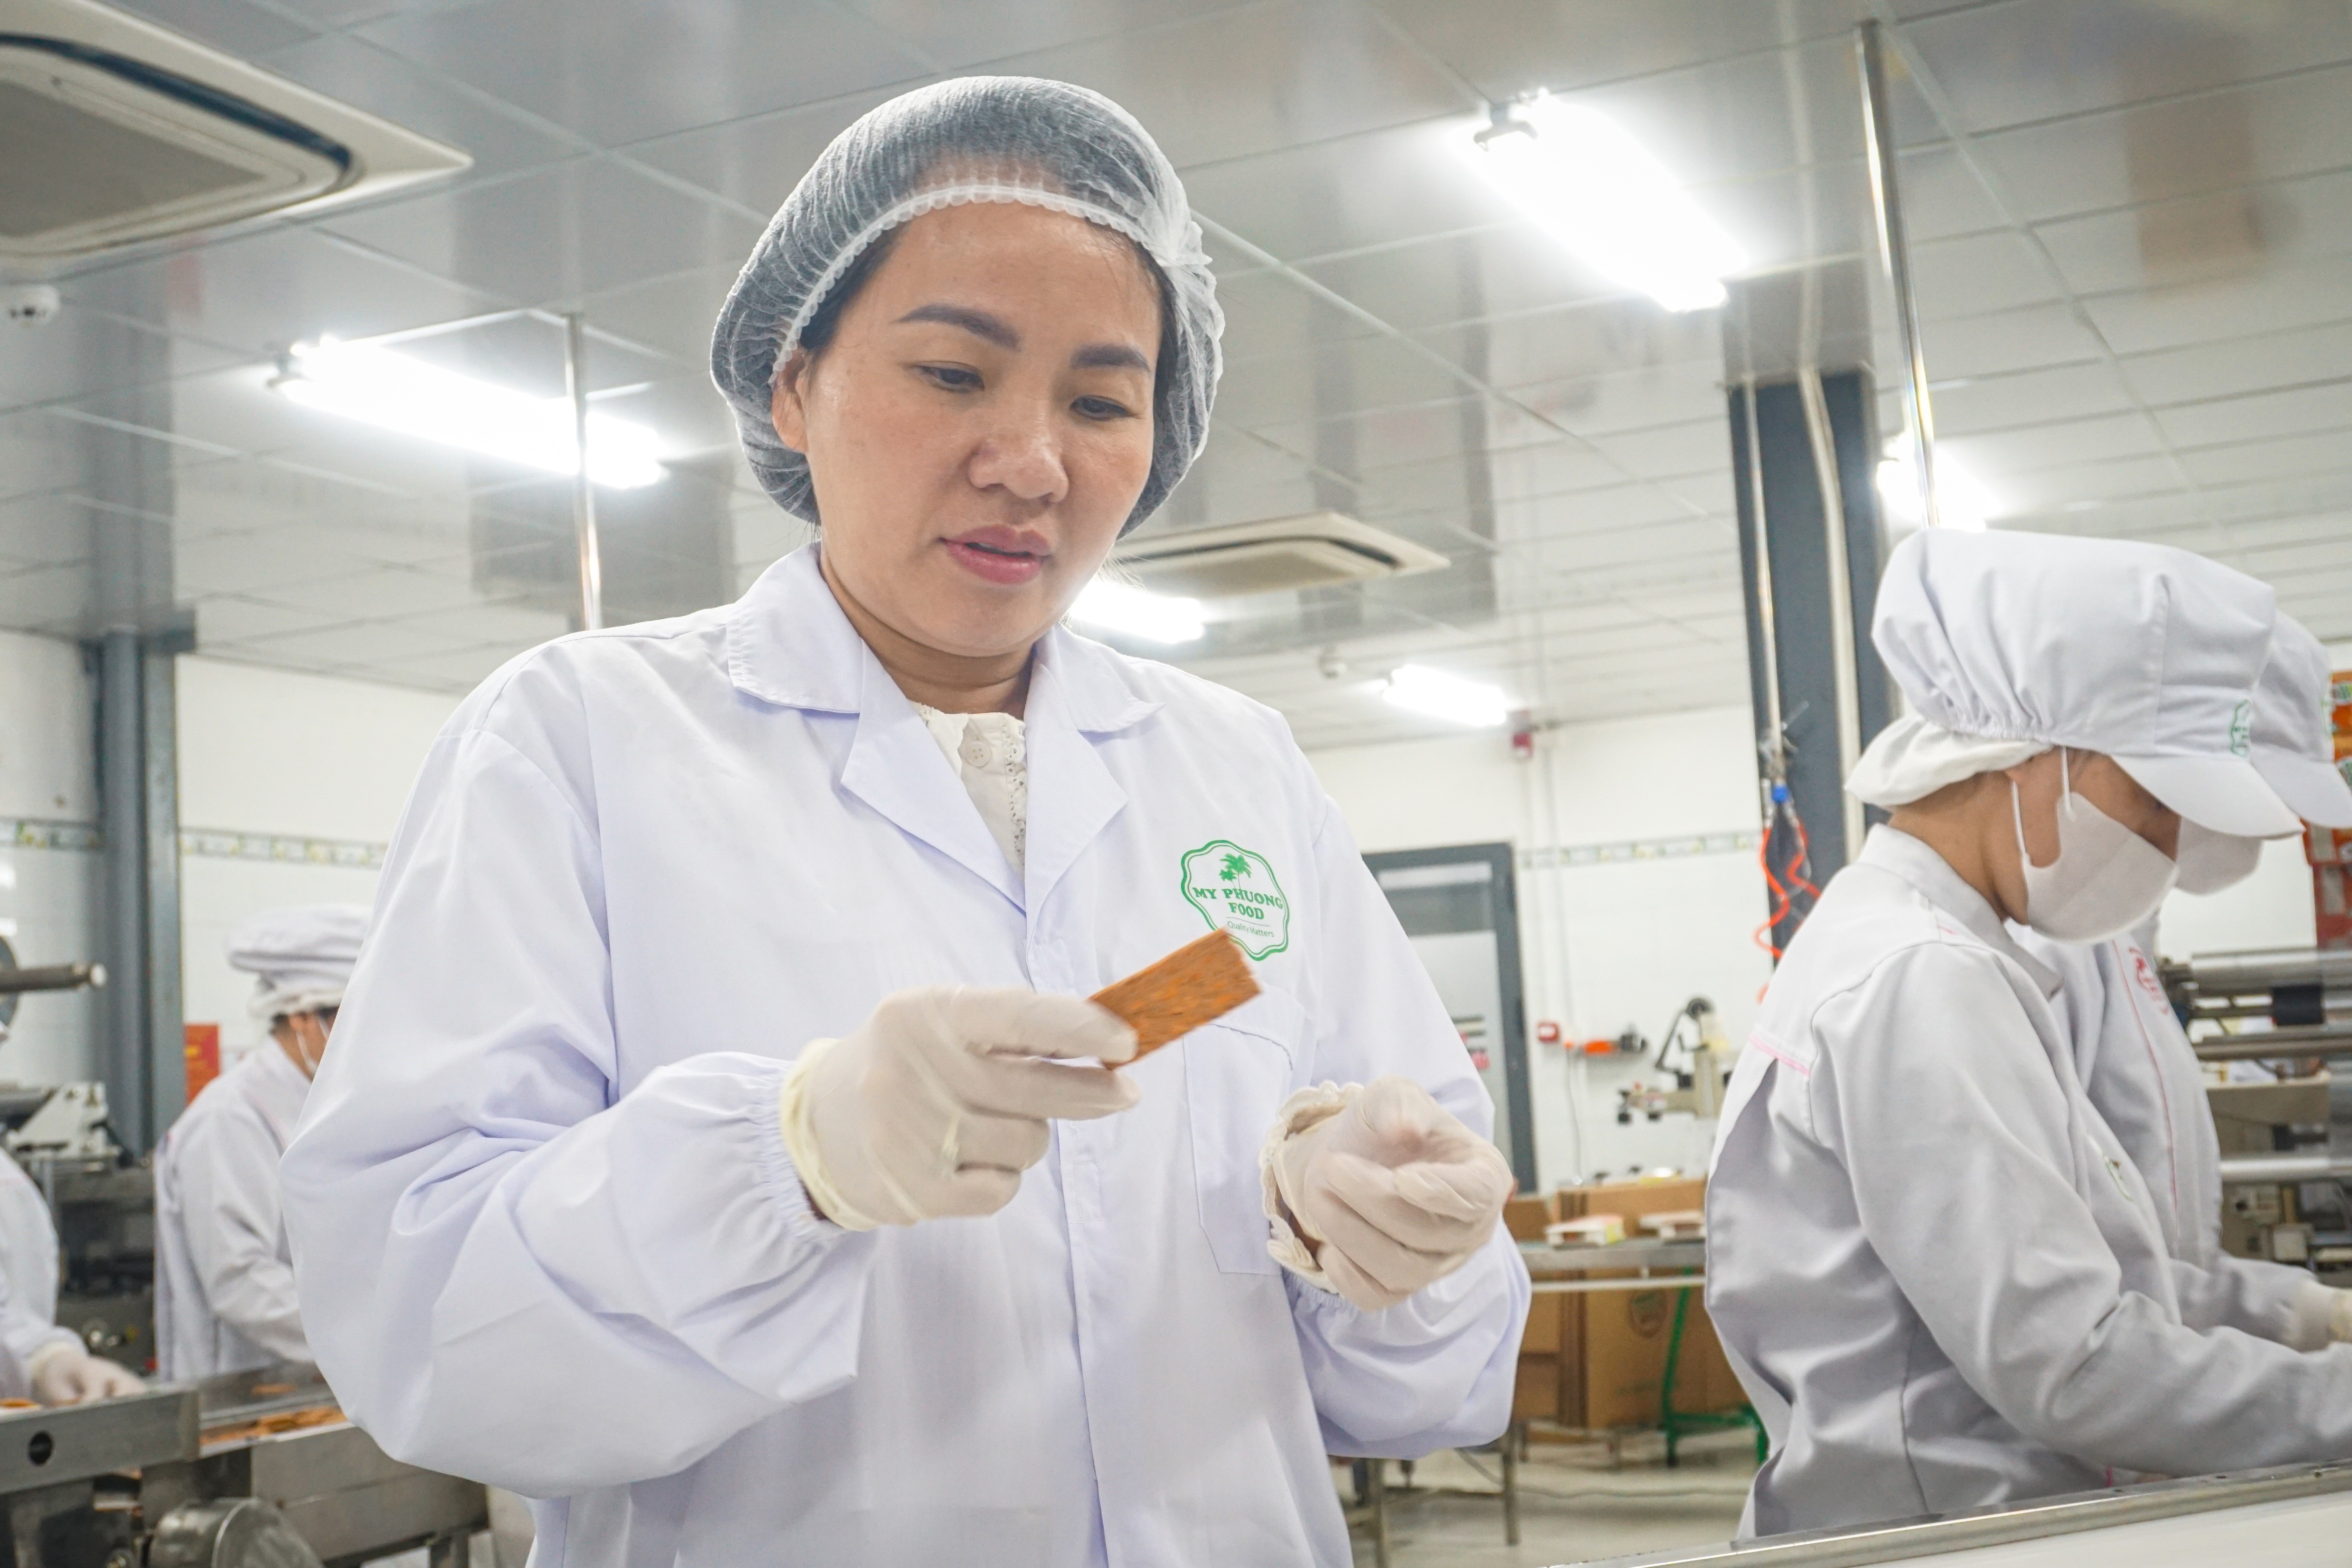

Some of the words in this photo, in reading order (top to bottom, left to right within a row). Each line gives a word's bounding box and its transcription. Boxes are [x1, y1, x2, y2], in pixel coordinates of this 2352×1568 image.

[1192, 887, 1217, 899] MY
[1222, 888, 1283, 909] PHUONG
[1228, 902, 1264, 919] FOOD
[1227, 921, 1249, 934] Quality
[1249, 926, 1274, 937] Matters
